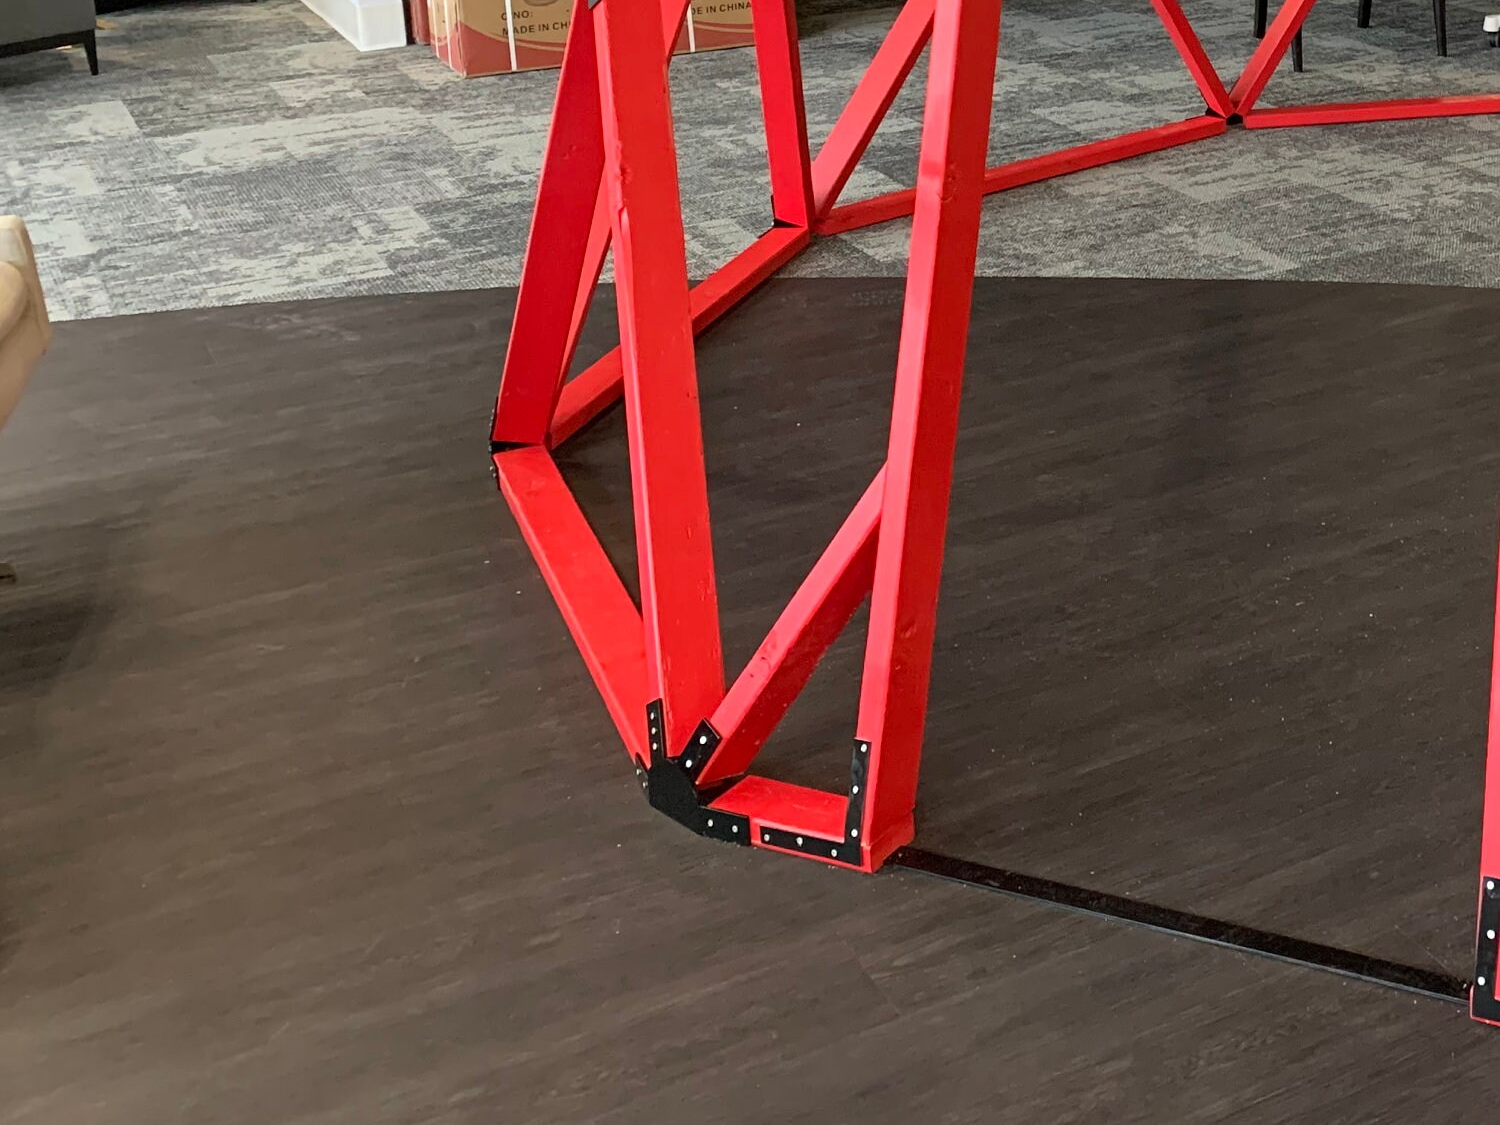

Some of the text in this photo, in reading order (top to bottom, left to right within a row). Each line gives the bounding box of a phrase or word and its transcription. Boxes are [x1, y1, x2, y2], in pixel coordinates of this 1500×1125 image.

[706, 5, 717, 14] IN
[719, 1, 752, 12] CHINA
[538, 22, 550, 32] IN
[552, 21, 571, 31] CHI
